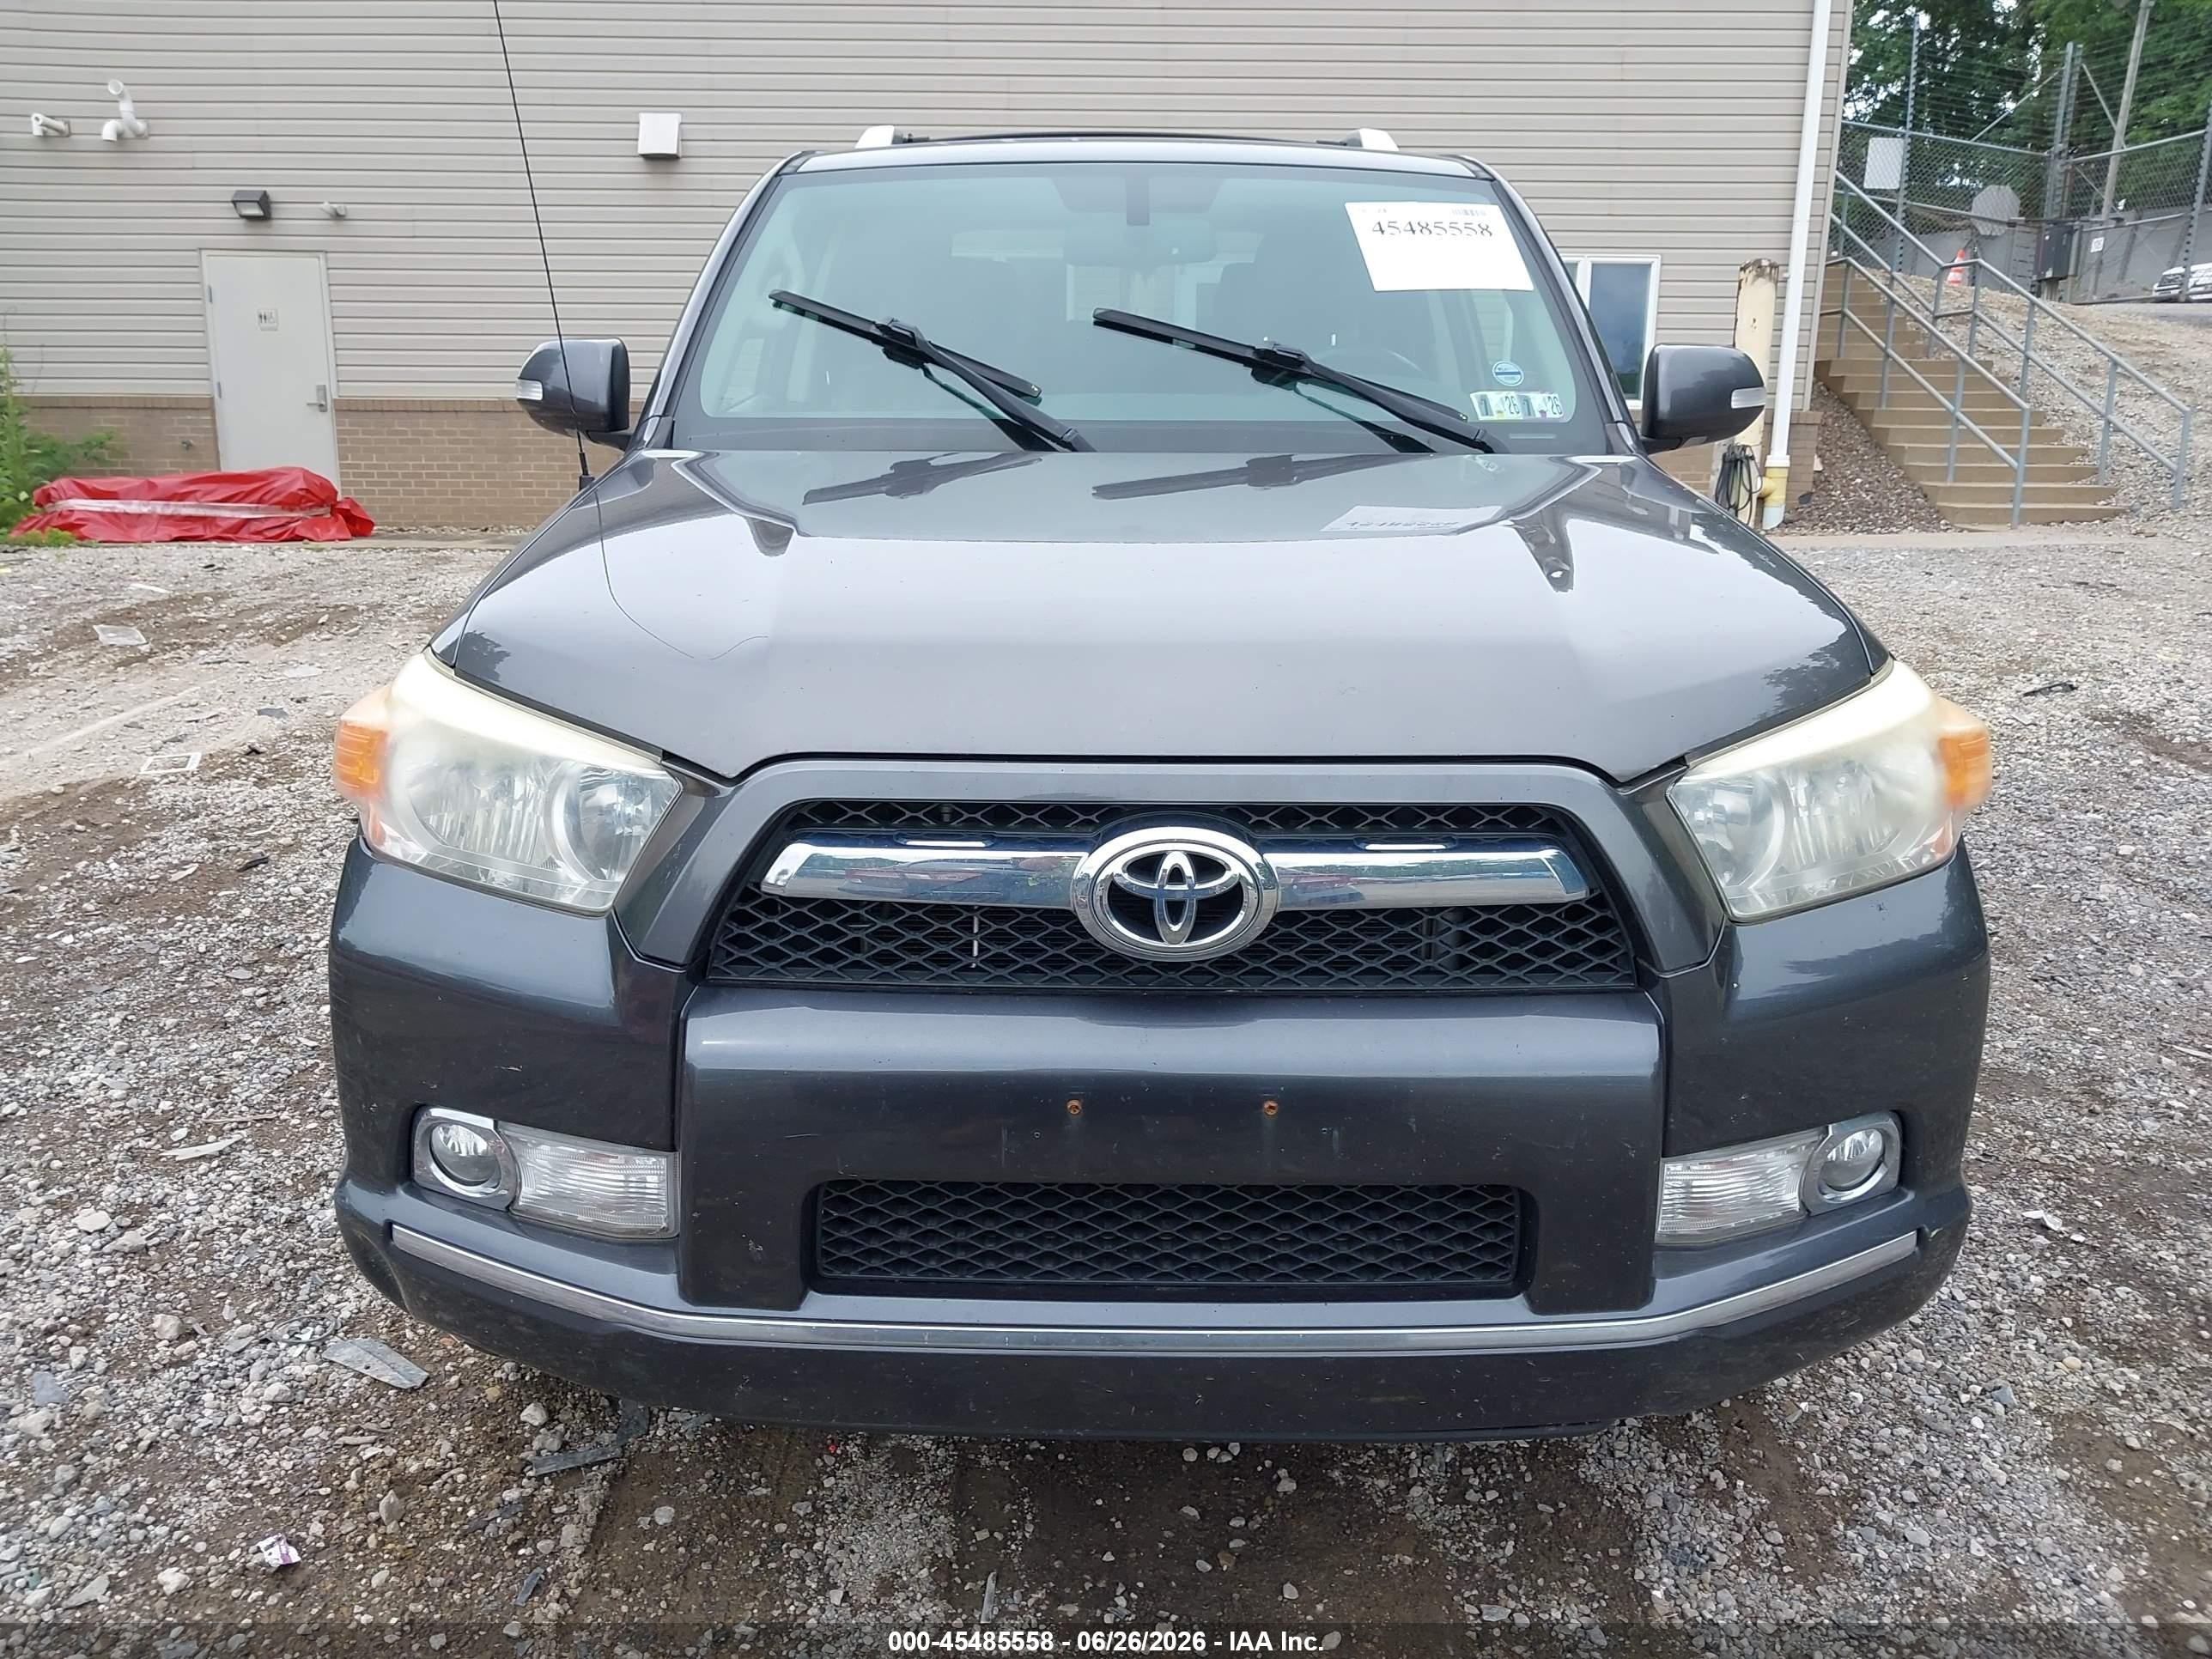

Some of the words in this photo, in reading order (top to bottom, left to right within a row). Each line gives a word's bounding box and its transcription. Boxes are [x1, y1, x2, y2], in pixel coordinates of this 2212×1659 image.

[1371, 220, 1493, 238] 45485558
[1504, 395, 1521, 415] 26
[1547, 395, 1563, 416] 26
